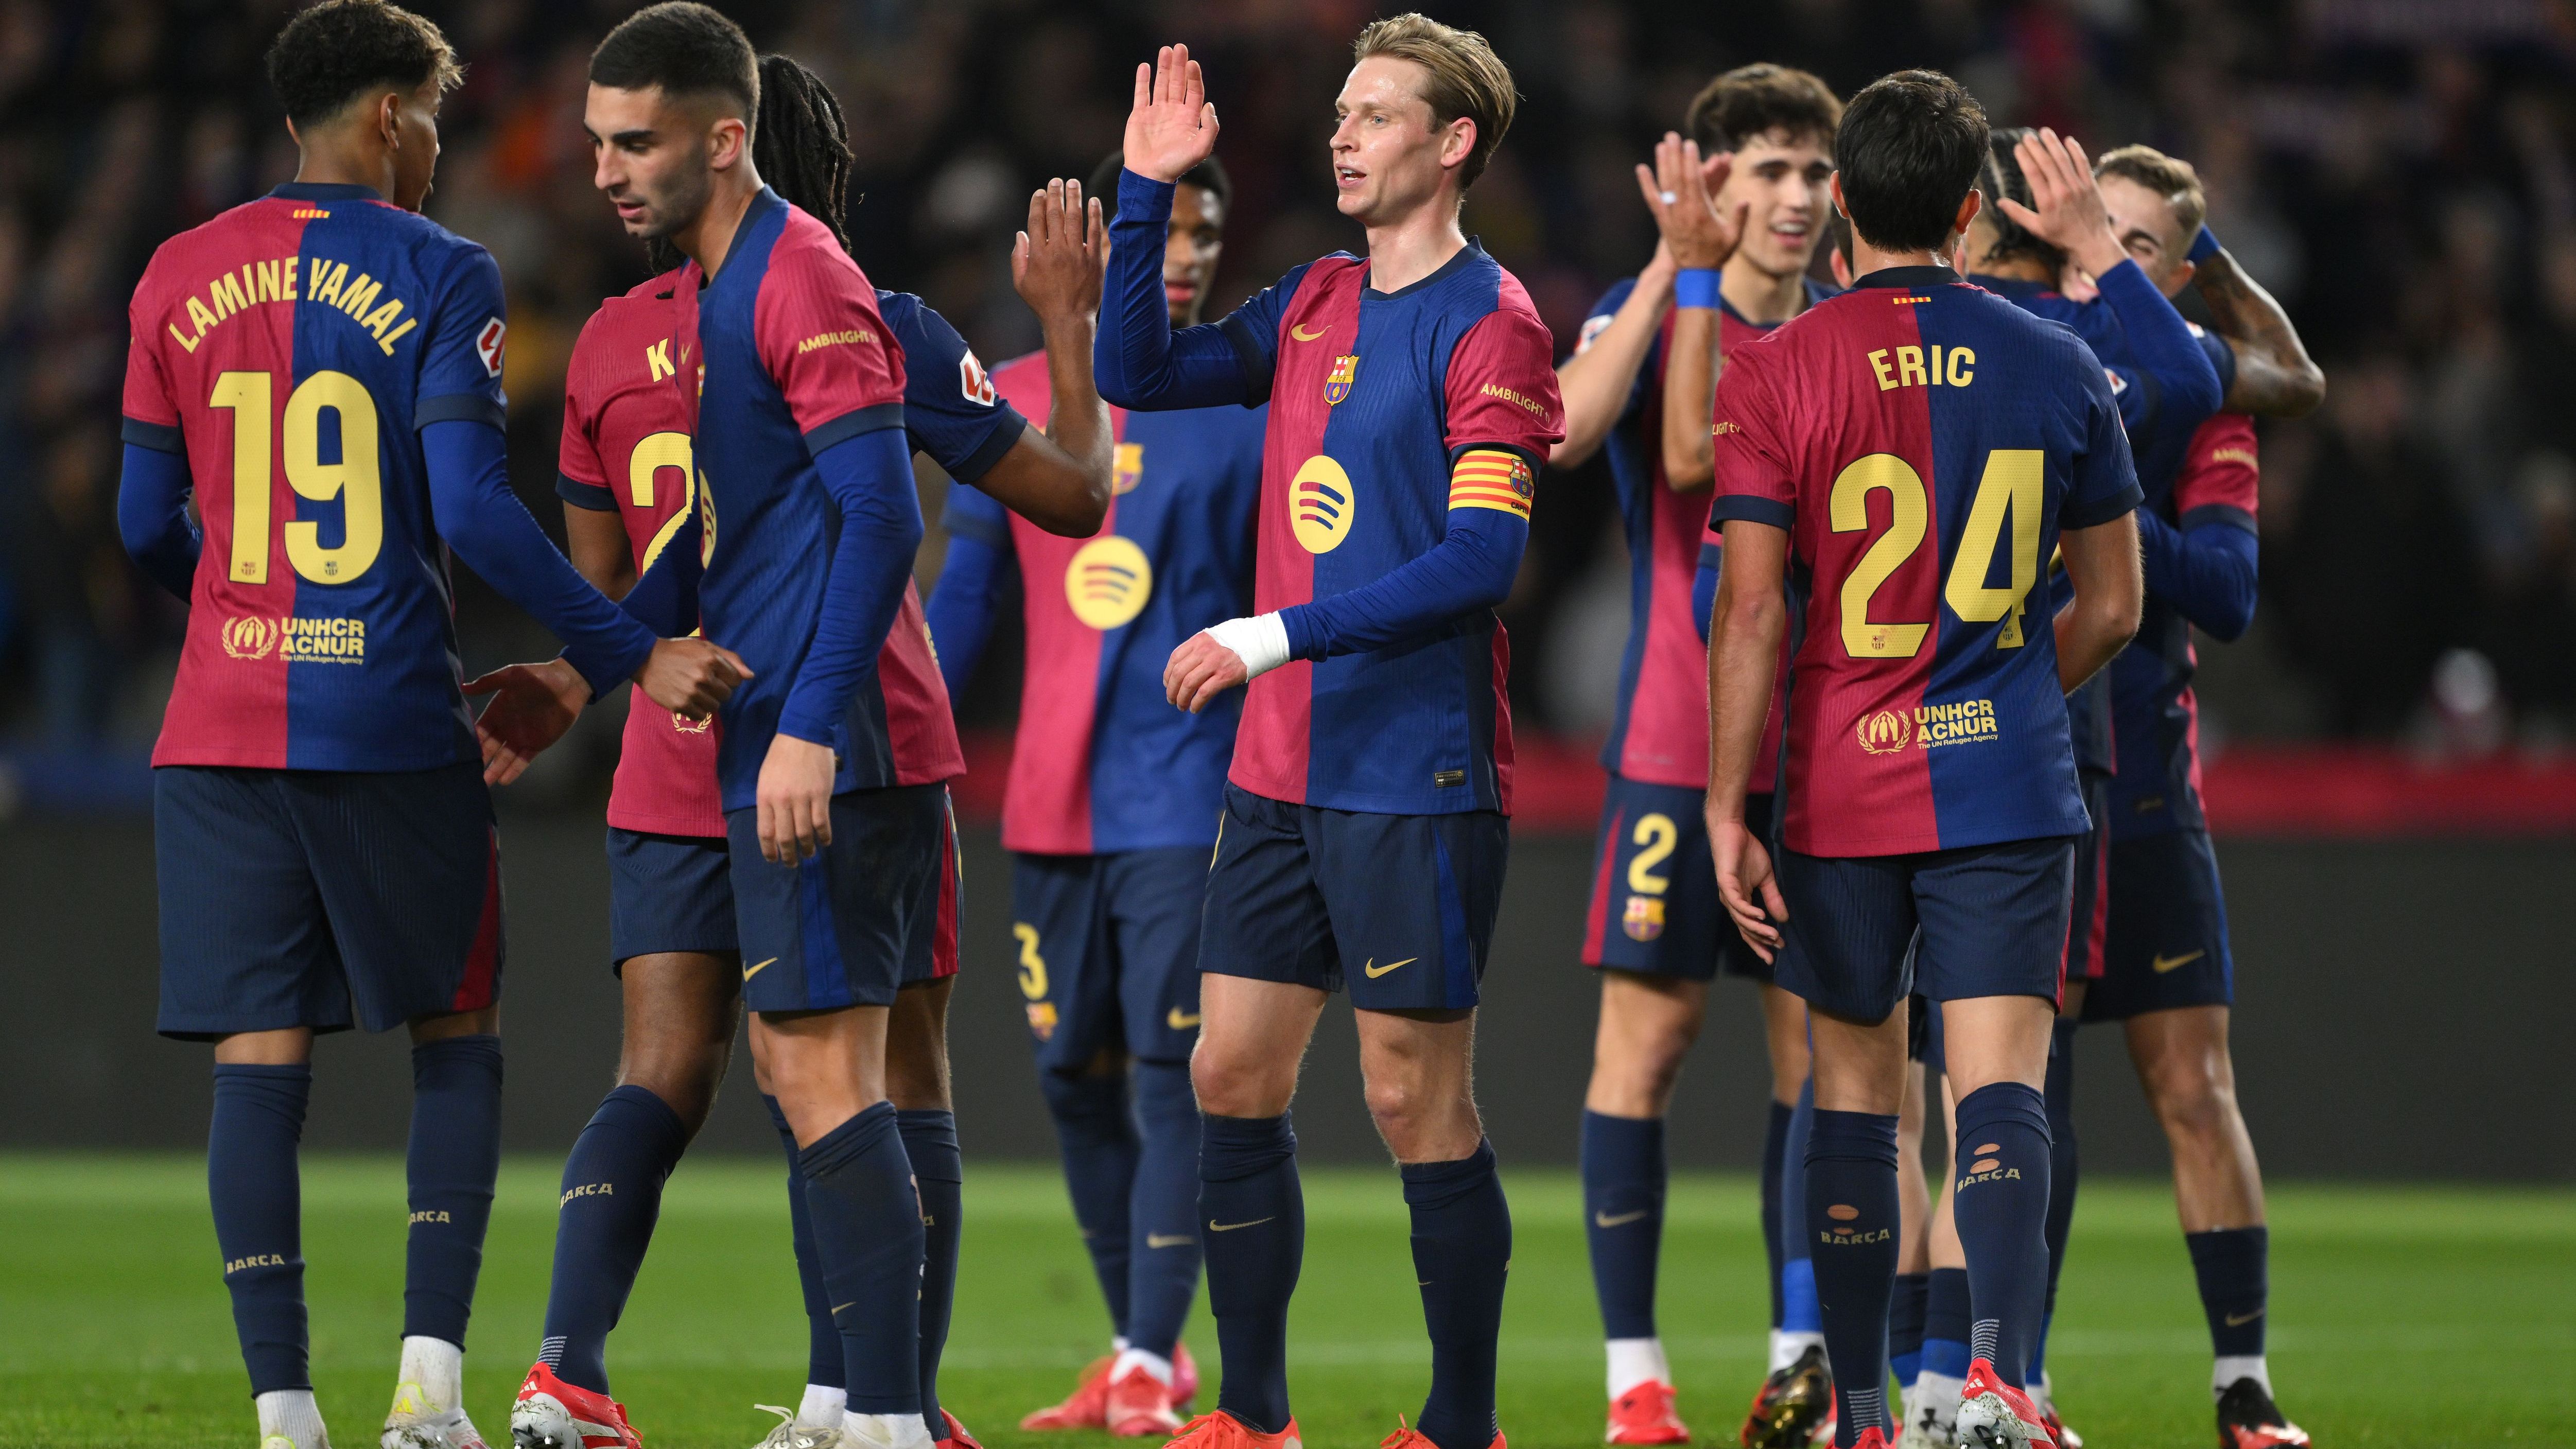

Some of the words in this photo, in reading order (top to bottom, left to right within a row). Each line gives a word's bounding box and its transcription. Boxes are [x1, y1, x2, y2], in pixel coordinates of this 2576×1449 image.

[169, 256, 298, 354] LAMINE
[307, 257, 417, 356] YAMAL
[798, 329, 869, 354] AMBILIGHT
[1867, 344, 1976, 391] ERIC
[1480, 383, 1544, 417] AMBILIGHT
[1729, 422, 1740, 433] tv
[208, 370, 383, 585] 19
[1829, 449, 2045, 659] 24
[281, 617, 365, 637] UNHCR
[279, 635, 364, 656] ACNUR
[305, 655, 335, 664] Refugee
[336, 656, 363, 666] Agency
[1914, 700, 1994, 725] UNHCR
[1916, 717, 1998, 743] ACNUR
[1943, 736, 1972, 745] Refugee
[1973, 734, 1998, 742] Agency
[1627, 813, 1678, 895] 2
[1013, 921, 1049, 1000] 3
[408, 1210, 450, 1227] ARÇA
